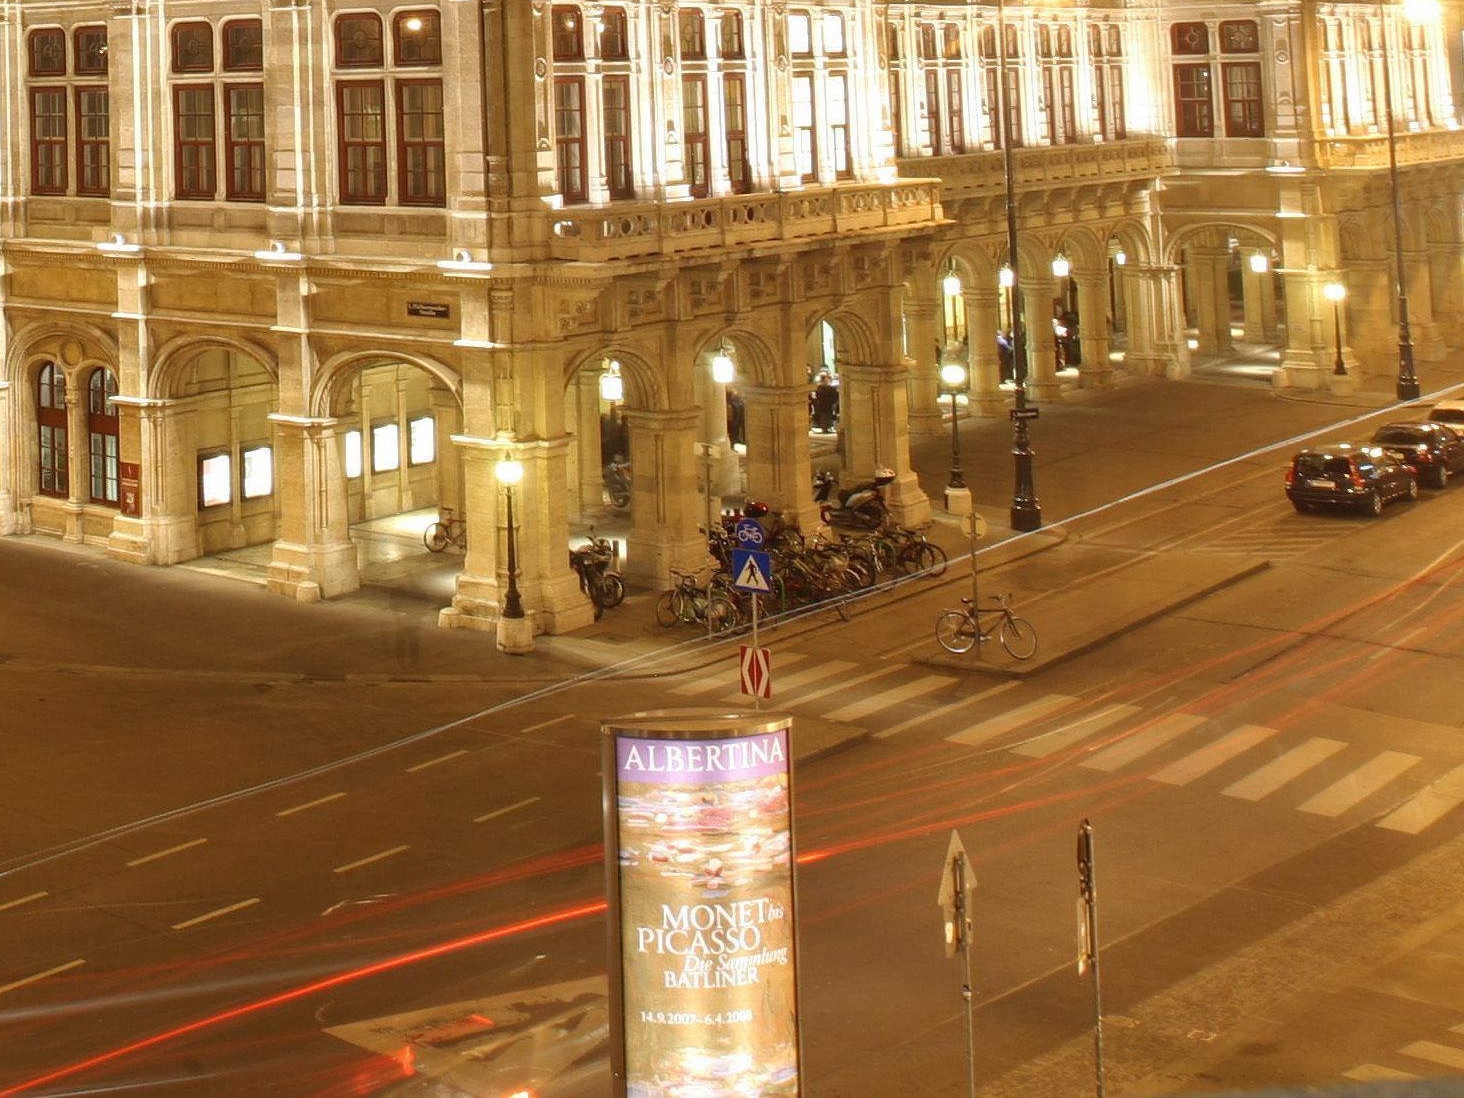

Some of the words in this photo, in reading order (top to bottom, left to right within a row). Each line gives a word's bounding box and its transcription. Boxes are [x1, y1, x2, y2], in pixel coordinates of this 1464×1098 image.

[623, 736, 785, 773] ALBERTINA
[661, 897, 769, 931] MONET
[767, 902, 785, 921] bis
[637, 925, 761, 955] PICASSO
[684, 954, 713, 972] Die
[716, 946, 788, 972] Sammlung
[663, 965, 760, 989] BATLINER
